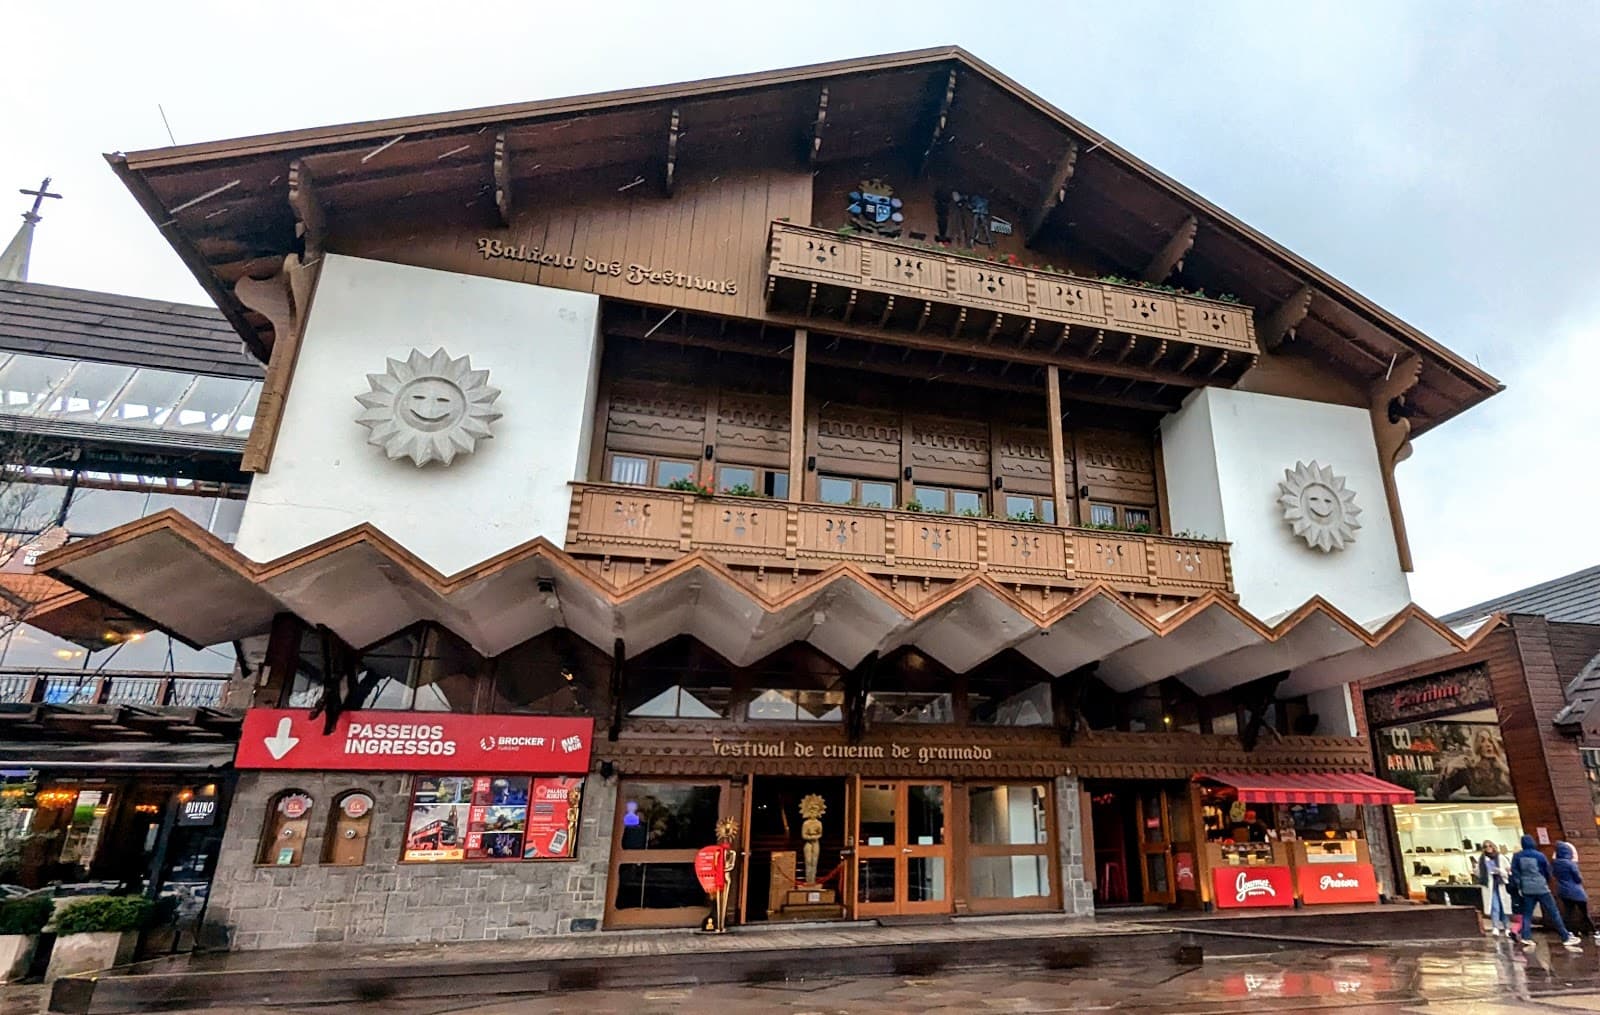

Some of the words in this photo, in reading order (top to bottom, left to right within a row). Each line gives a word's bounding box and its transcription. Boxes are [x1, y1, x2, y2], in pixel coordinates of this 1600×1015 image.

[584, 255, 622, 276] dos
[626, 263, 737, 295] Festivais
[347, 723, 444, 740] PASSEIOS
[344, 739, 456, 756] INGRESSOS
[498, 736, 544, 746] BROCKER
[794, 742, 813, 757] de
[822, 744, 884, 758] cinema
[891, 744, 910, 758] de
[918, 746, 992, 763] gramado
[185, 801, 214, 814] DIVINO
